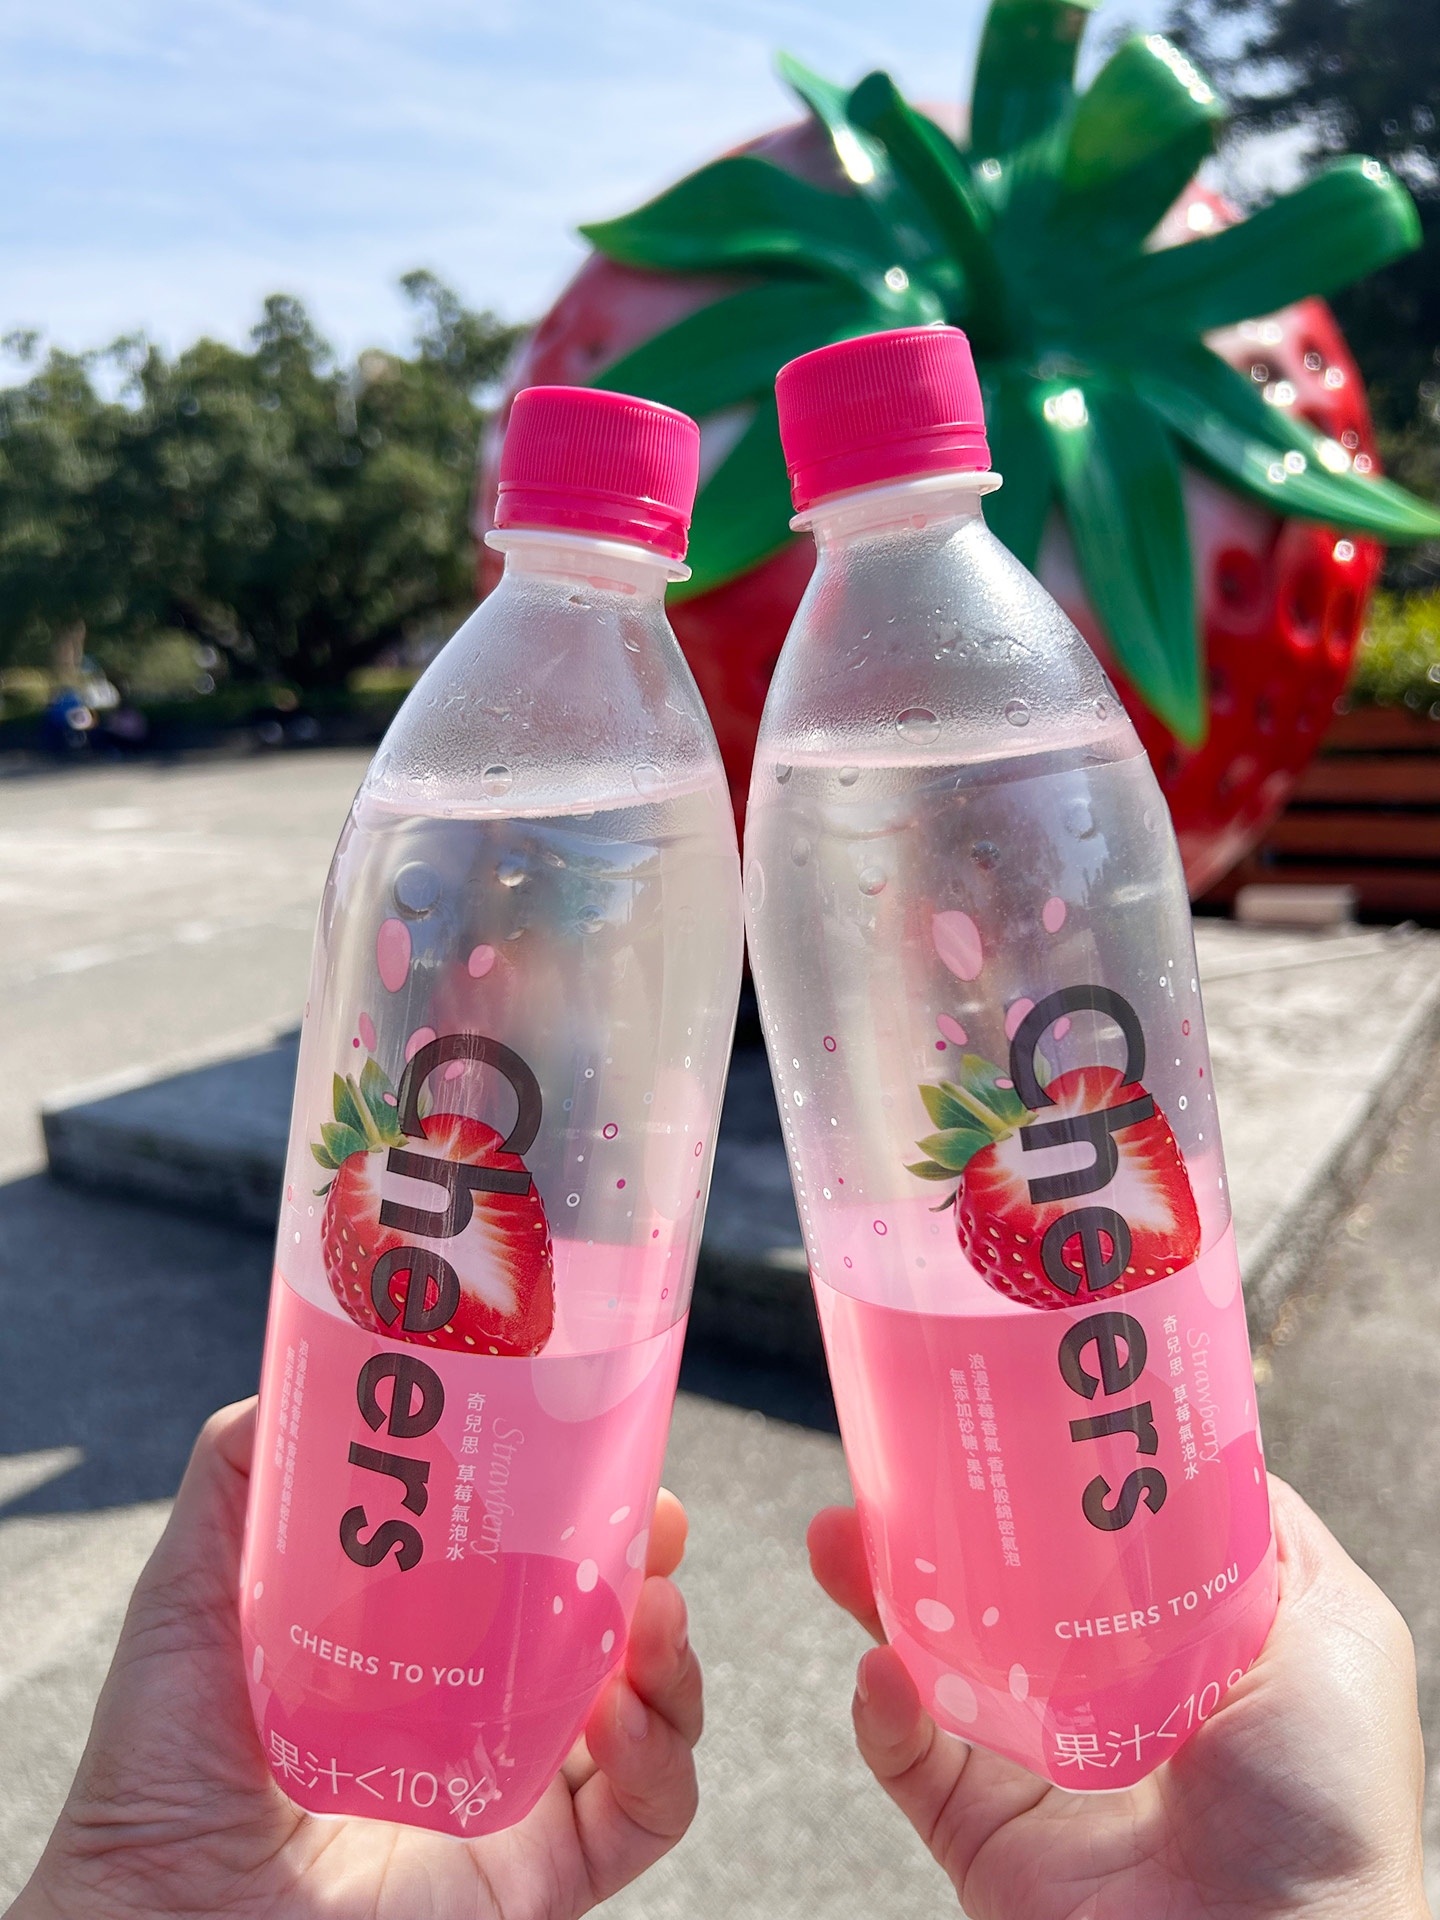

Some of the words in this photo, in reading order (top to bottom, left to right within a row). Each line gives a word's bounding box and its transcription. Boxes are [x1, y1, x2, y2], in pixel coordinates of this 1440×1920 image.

[339, 1033, 542, 1572] Cheers
[1009, 984, 1168, 1531] Cheers
[459, 1392, 487, 1454] 奇兒思
[1162, 1314, 1184, 1377] 奇兒思
[1173, 1383, 1199, 1480] 草莓氣泡水
[1187, 1328, 1221, 1463] Strawberry
[446, 1463, 476, 1562] 草莓氣泡水
[470, 1417, 525, 1564] Strawberry
[290, 1624, 380, 1677] CHEERS
[389, 1660, 425, 1684] TO
[431, 1664, 486, 1688] YOU
[1055, 1604, 1161, 1640] CHEERS
[1168, 1590, 1200, 1616] TO
[1202, 1562, 1240, 1602] YOU
